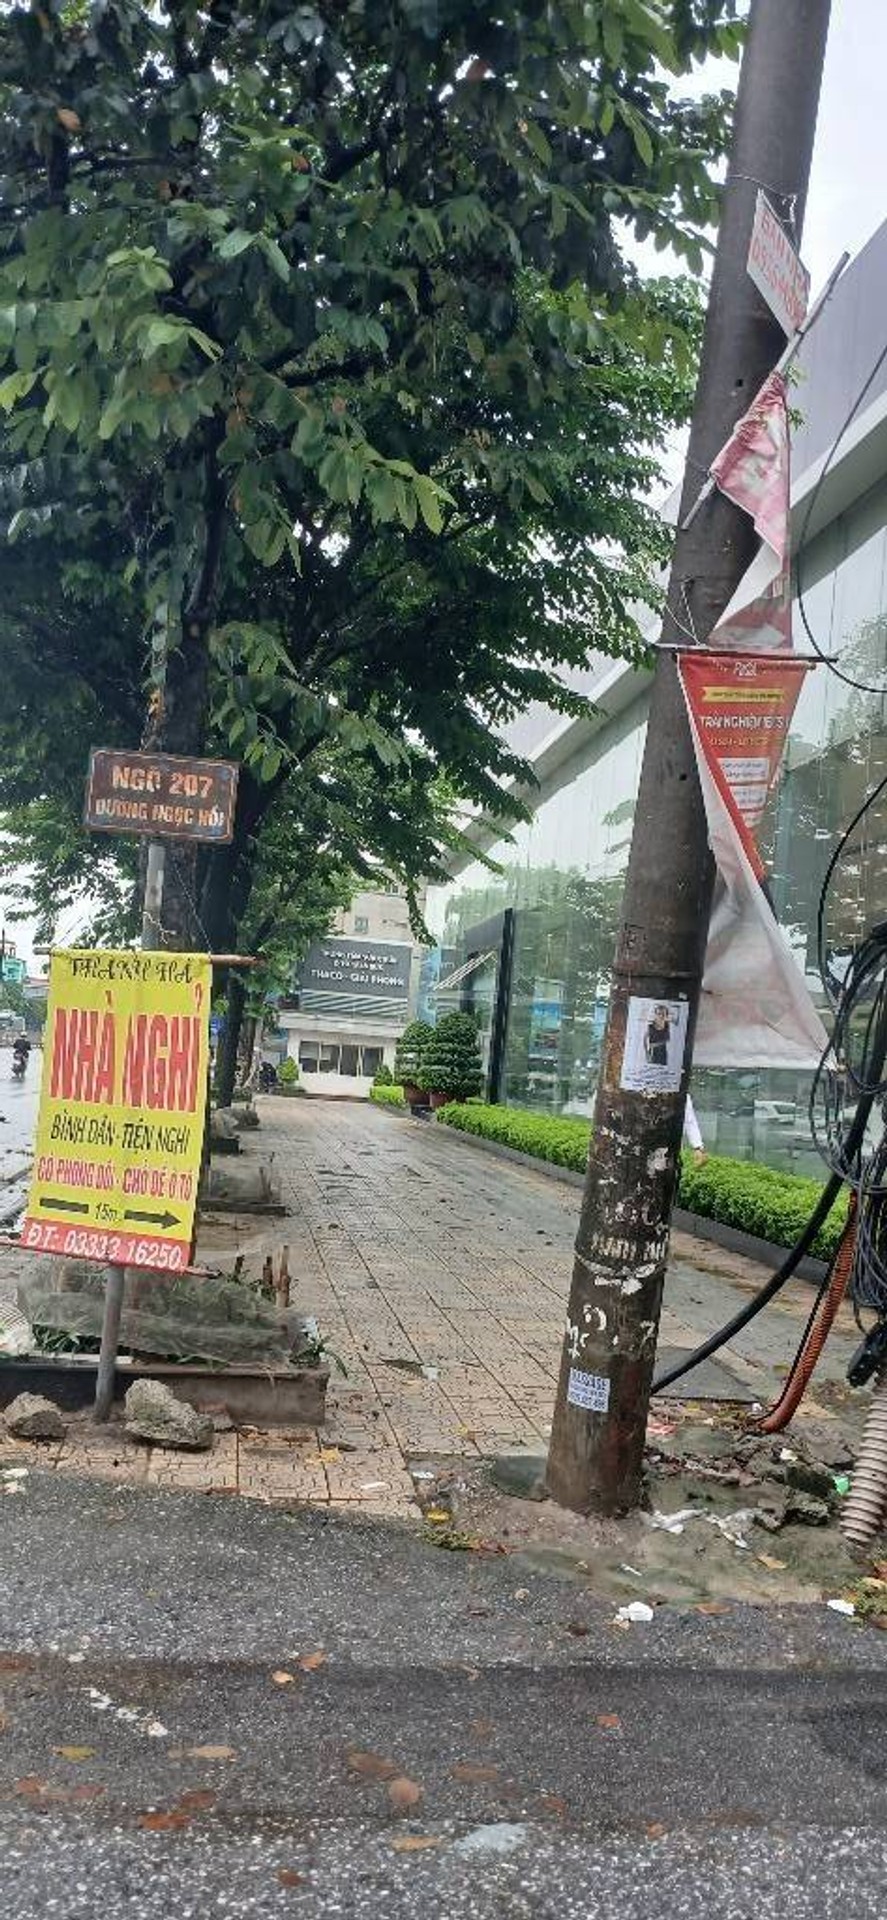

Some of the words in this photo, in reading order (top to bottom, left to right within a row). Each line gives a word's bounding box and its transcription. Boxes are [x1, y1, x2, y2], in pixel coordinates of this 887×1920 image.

[168, 772, 214, 798] 207
[152, 803, 194, 826] NGỌC
[50, 989, 115, 1105] NHÀ
[122, 983, 203, 1113] NGHỈ
[51, 1109, 88, 1145] BÌNH
[88, 1115, 116, 1147] DÂN
[122, 1118, 155, 1154] TIỆN
[156, 1124, 191, 1155] NGHI
[37, 1152, 55, 1183] CÓ
[27, 1222, 60, 1249] ĐT:
[63, 1229, 121, 1262] 03333
[126, 1240, 182, 1271] 16250
